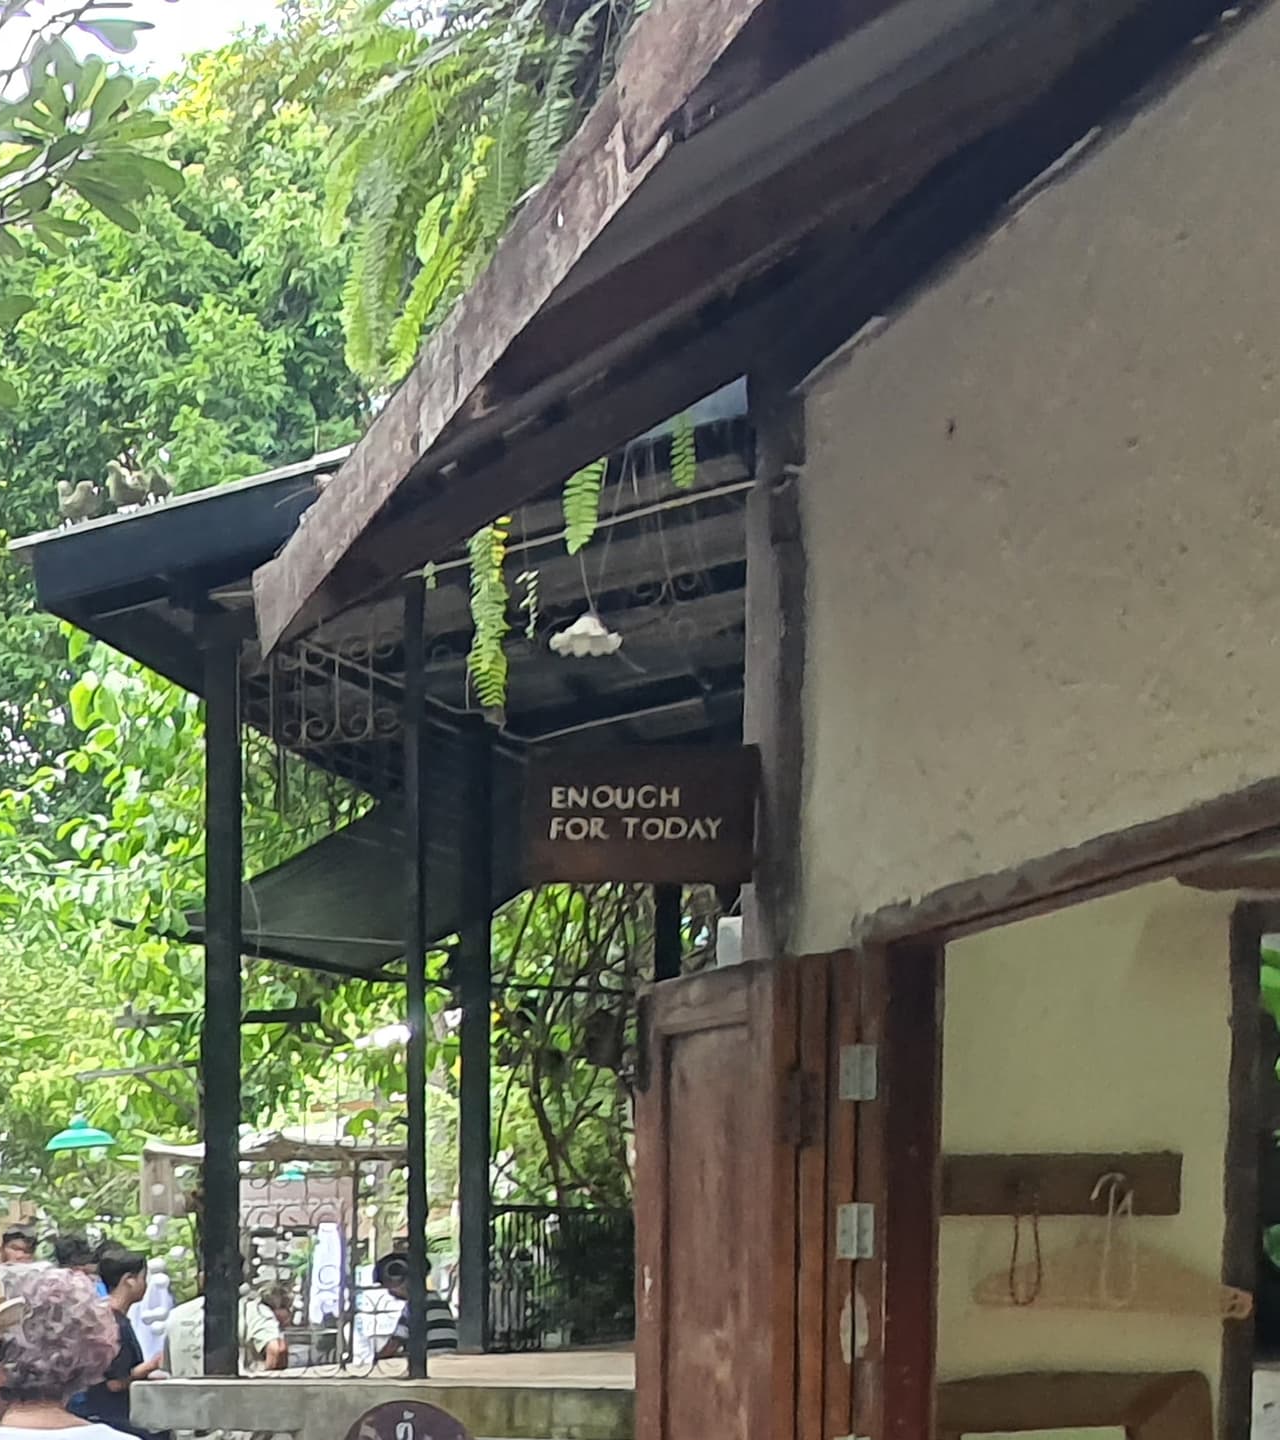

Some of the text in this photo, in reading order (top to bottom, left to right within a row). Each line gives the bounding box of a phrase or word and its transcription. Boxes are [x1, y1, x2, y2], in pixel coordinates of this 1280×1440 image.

[550, 785, 681, 809] ENOUGH
[549, 816, 723, 840] FOR TODAY
